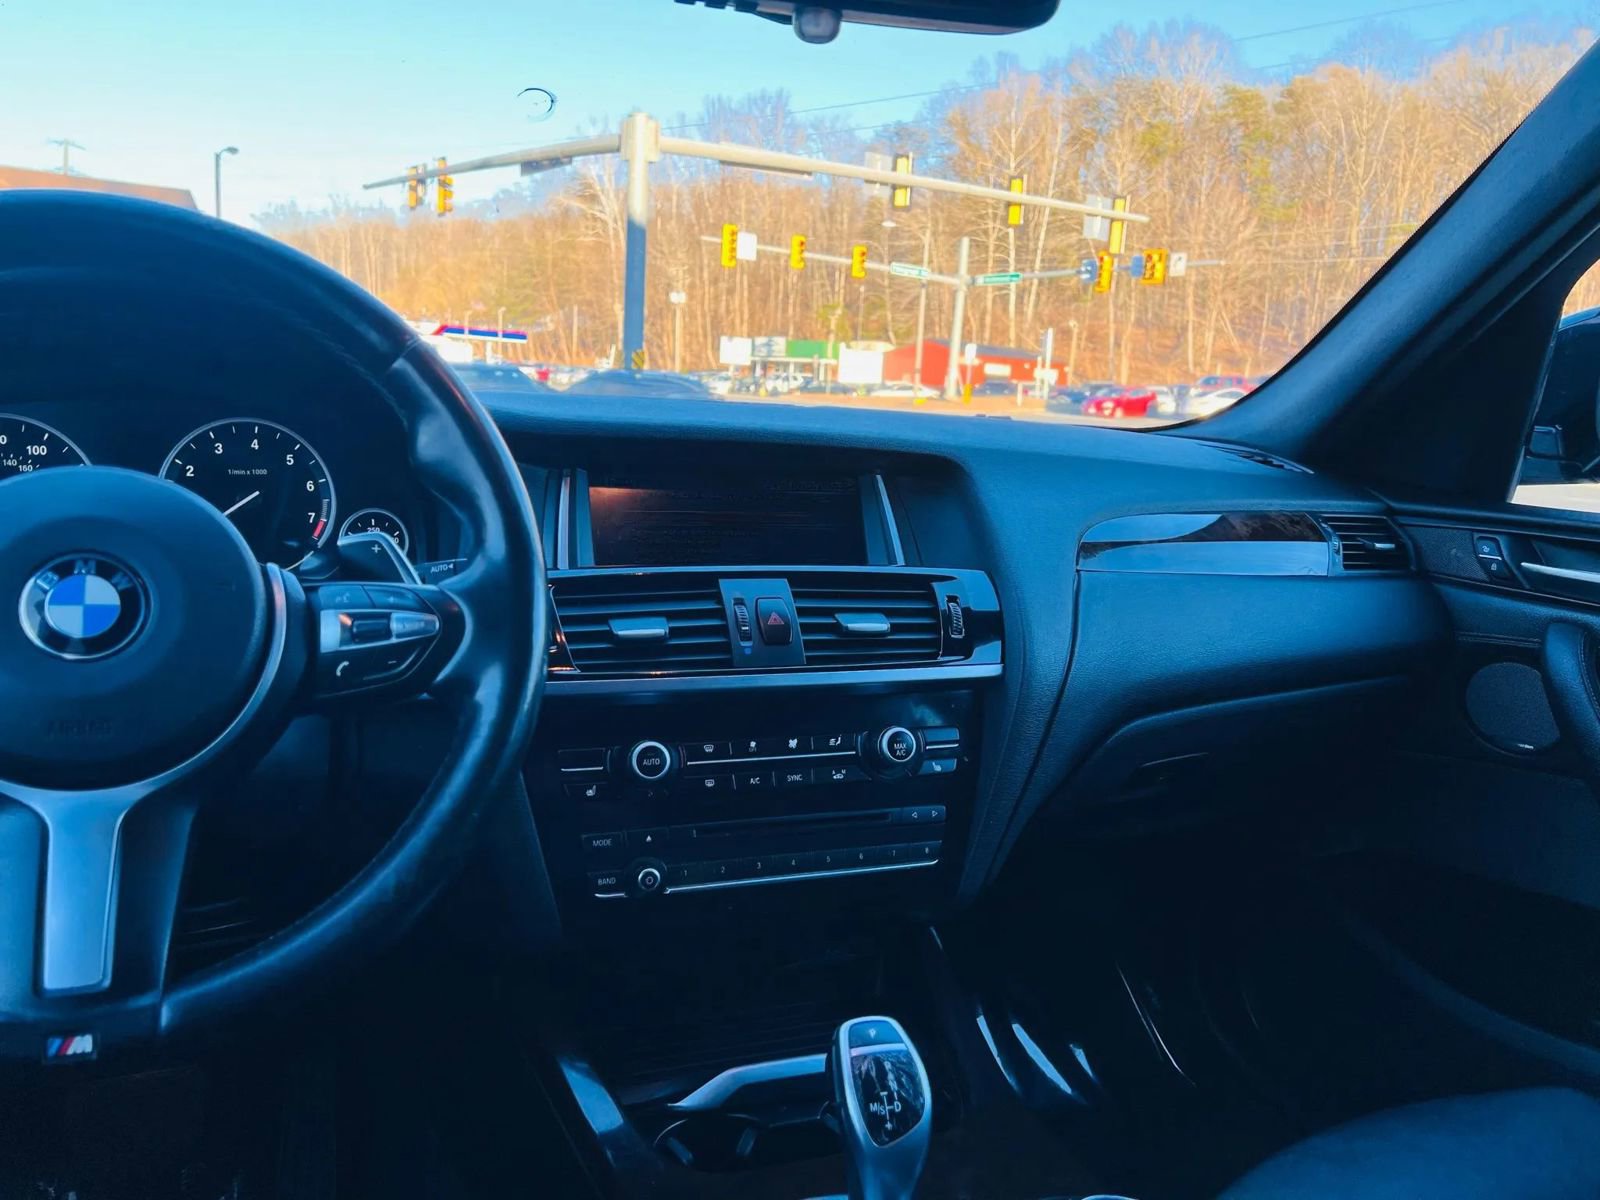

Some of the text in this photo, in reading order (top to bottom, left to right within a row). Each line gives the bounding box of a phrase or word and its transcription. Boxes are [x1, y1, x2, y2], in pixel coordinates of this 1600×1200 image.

[214, 443, 223, 454] 3
[250, 439, 259, 450] 4
[26, 445, 47, 455] 100
[286, 454, 294, 465] 5
[19, 464, 33, 472] 160
[185, 465, 195, 477] 2
[306, 481, 315, 491] 6
[308, 512, 316, 523] 7
[431, 564, 448, 573] AUTO
[643, 758, 660, 766] AUTO
[787, 774, 802, 782] SYNC
[593, 839, 612, 847] MODE
[598, 877, 616, 885] BAND
[869, 1101, 902, 1115] M/S D
